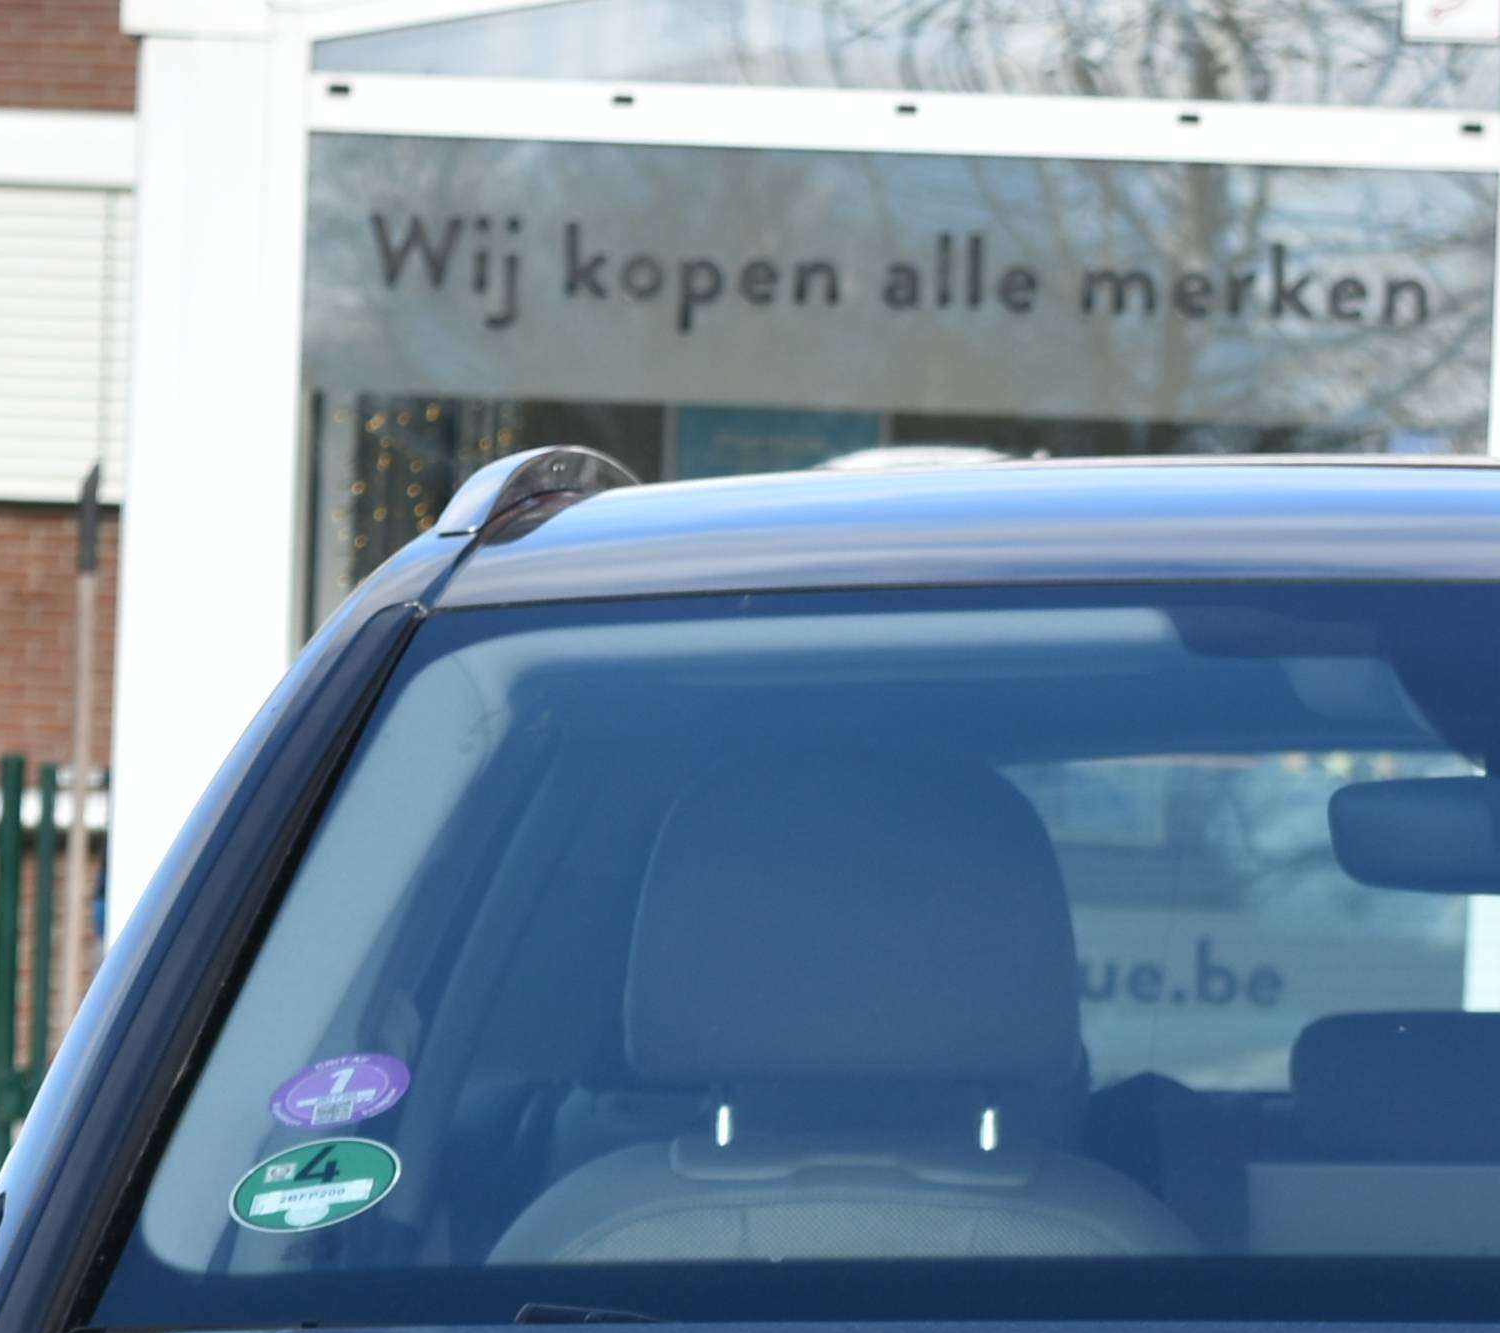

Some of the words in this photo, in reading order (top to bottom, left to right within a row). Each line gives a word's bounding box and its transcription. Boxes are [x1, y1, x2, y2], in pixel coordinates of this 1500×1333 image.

[369, 212, 521, 330] Wij
[564, 221, 839, 335] kopen
[883, 233, 1039, 315] alle
[1080, 244, 1429, 325] merken
[329, 1067, 355, 1095] 1
[294, 1144, 339, 1184] 4
